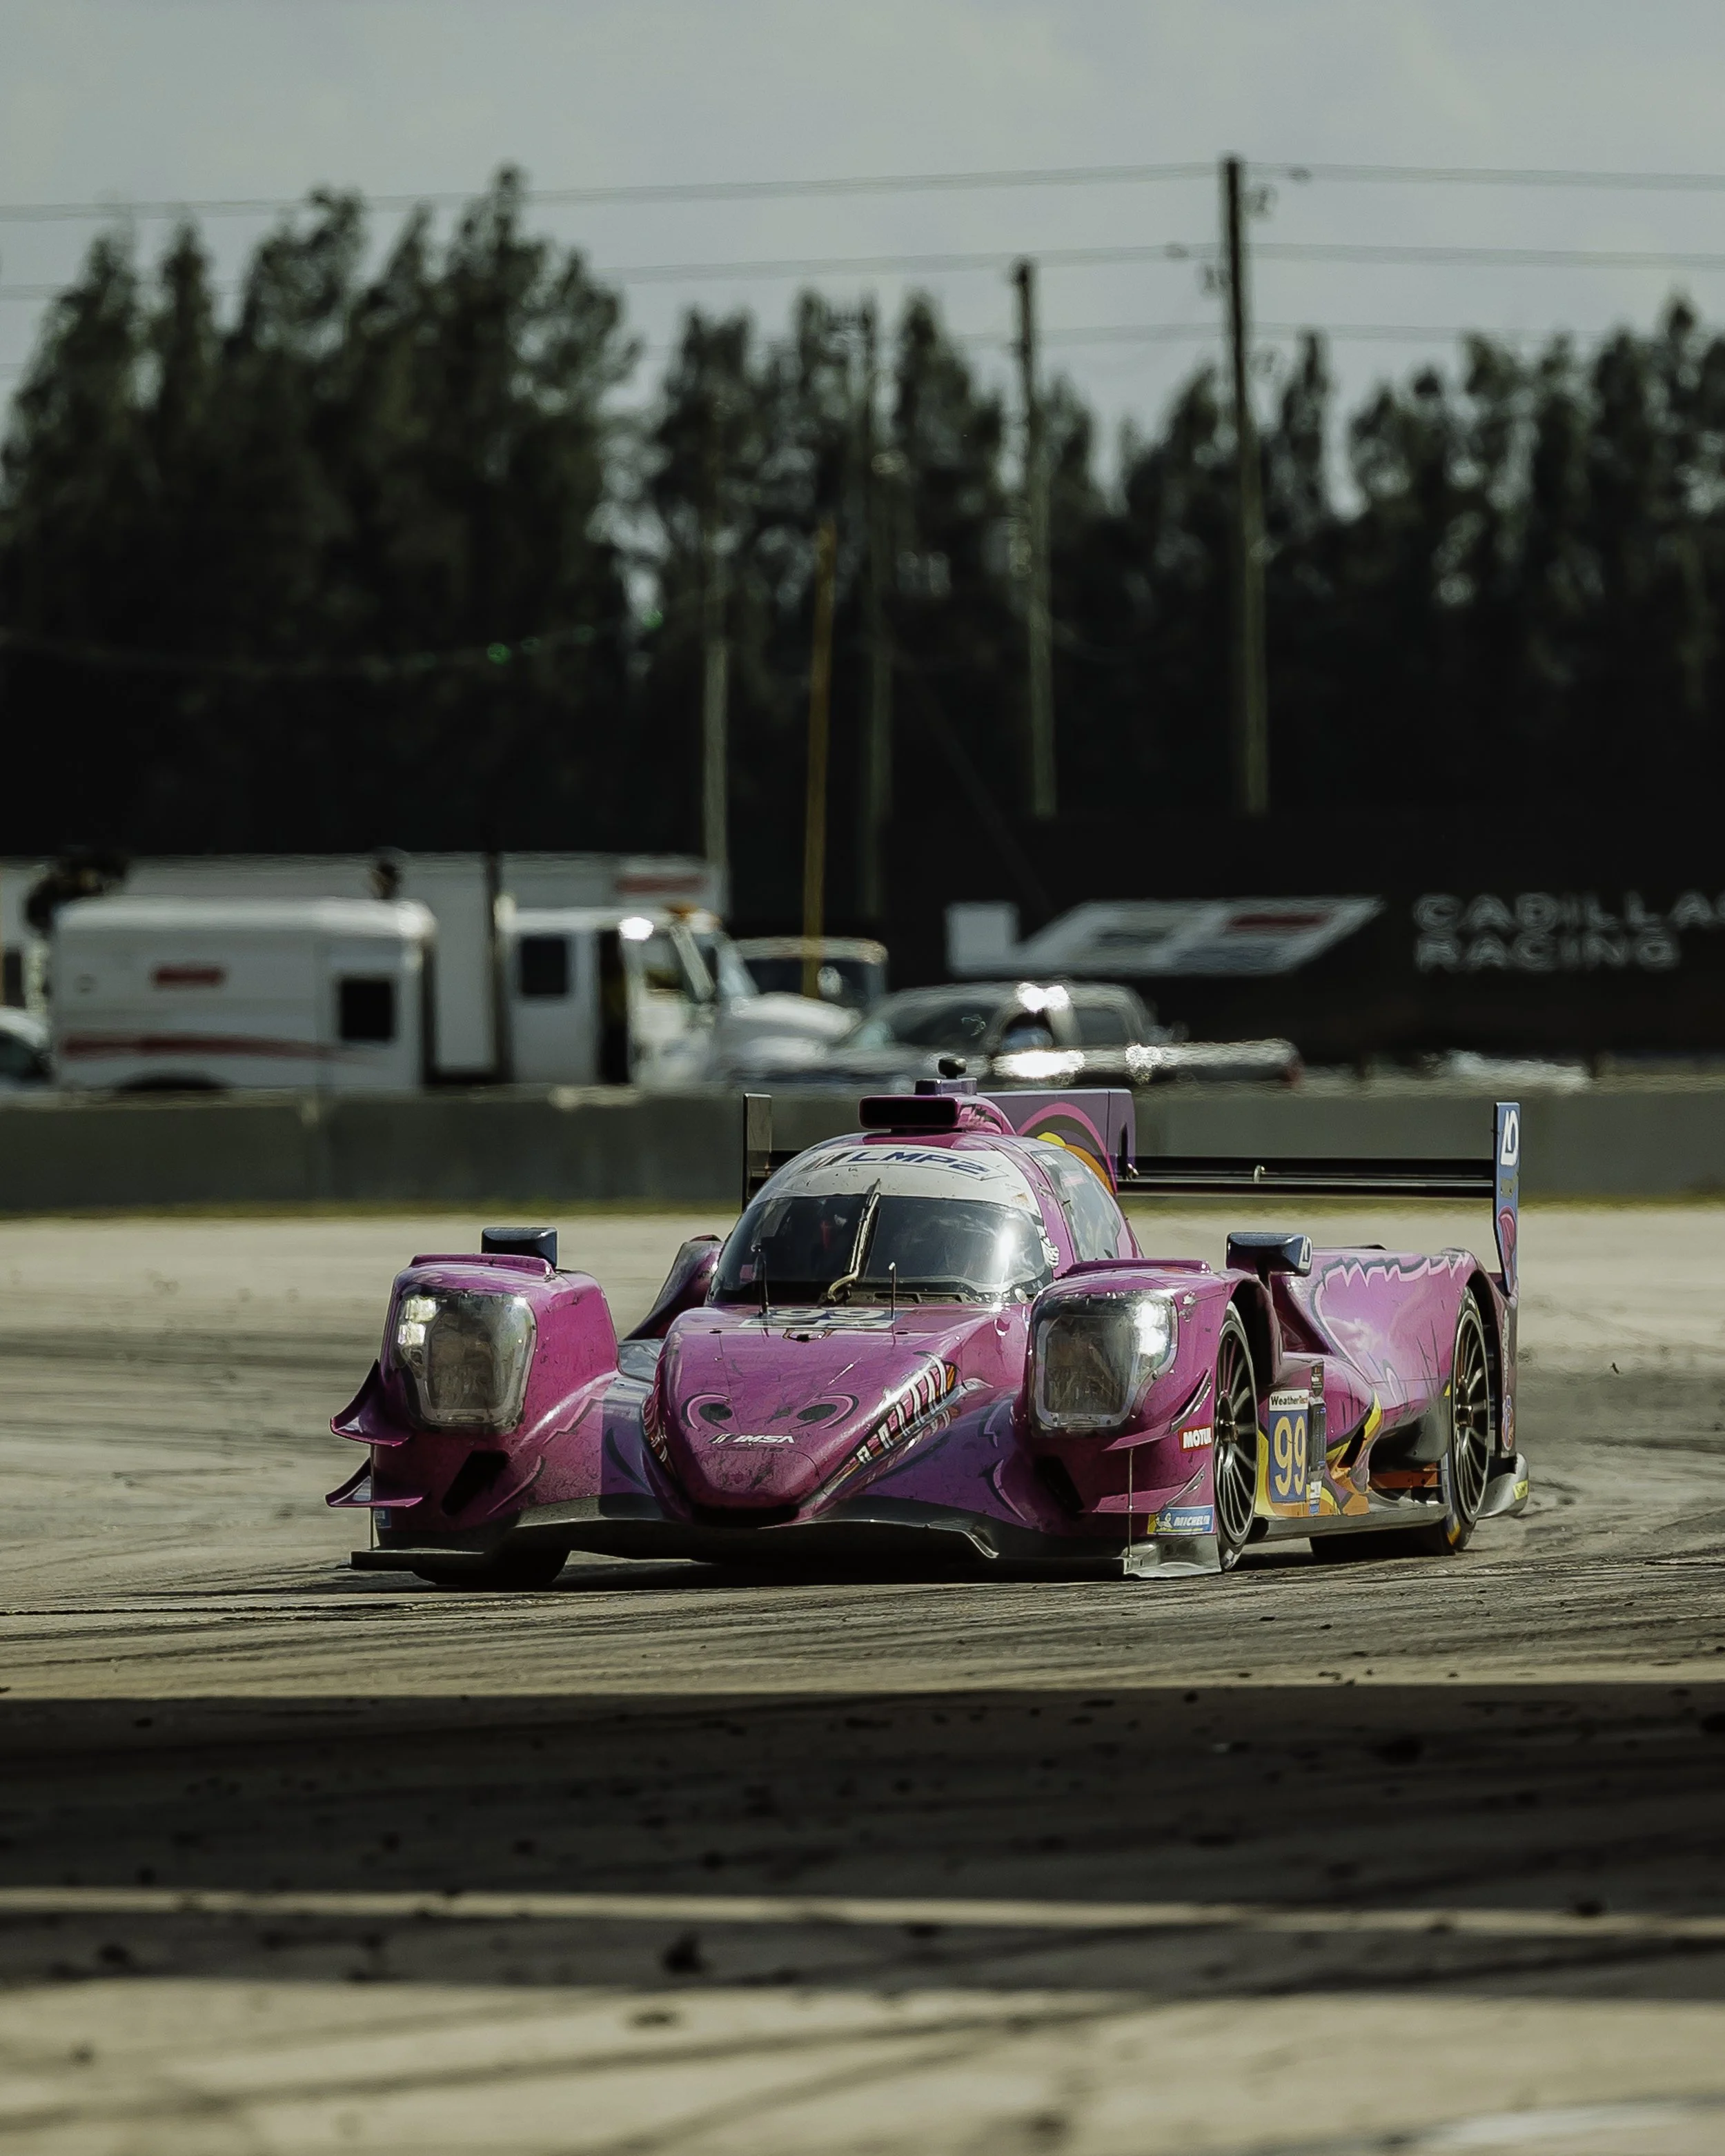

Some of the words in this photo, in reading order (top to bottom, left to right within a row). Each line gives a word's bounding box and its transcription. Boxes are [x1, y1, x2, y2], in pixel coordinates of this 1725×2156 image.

[1414, 892, 1725, 931] CADILLA
[1417, 929, 1679, 971] RACING
[847, 1151, 990, 1174] LMP2
[733, 1435, 795, 1444] IMSA
[1183, 1427, 1212, 1449] MOTUL
[1274, 1416, 1306, 1496] 99
